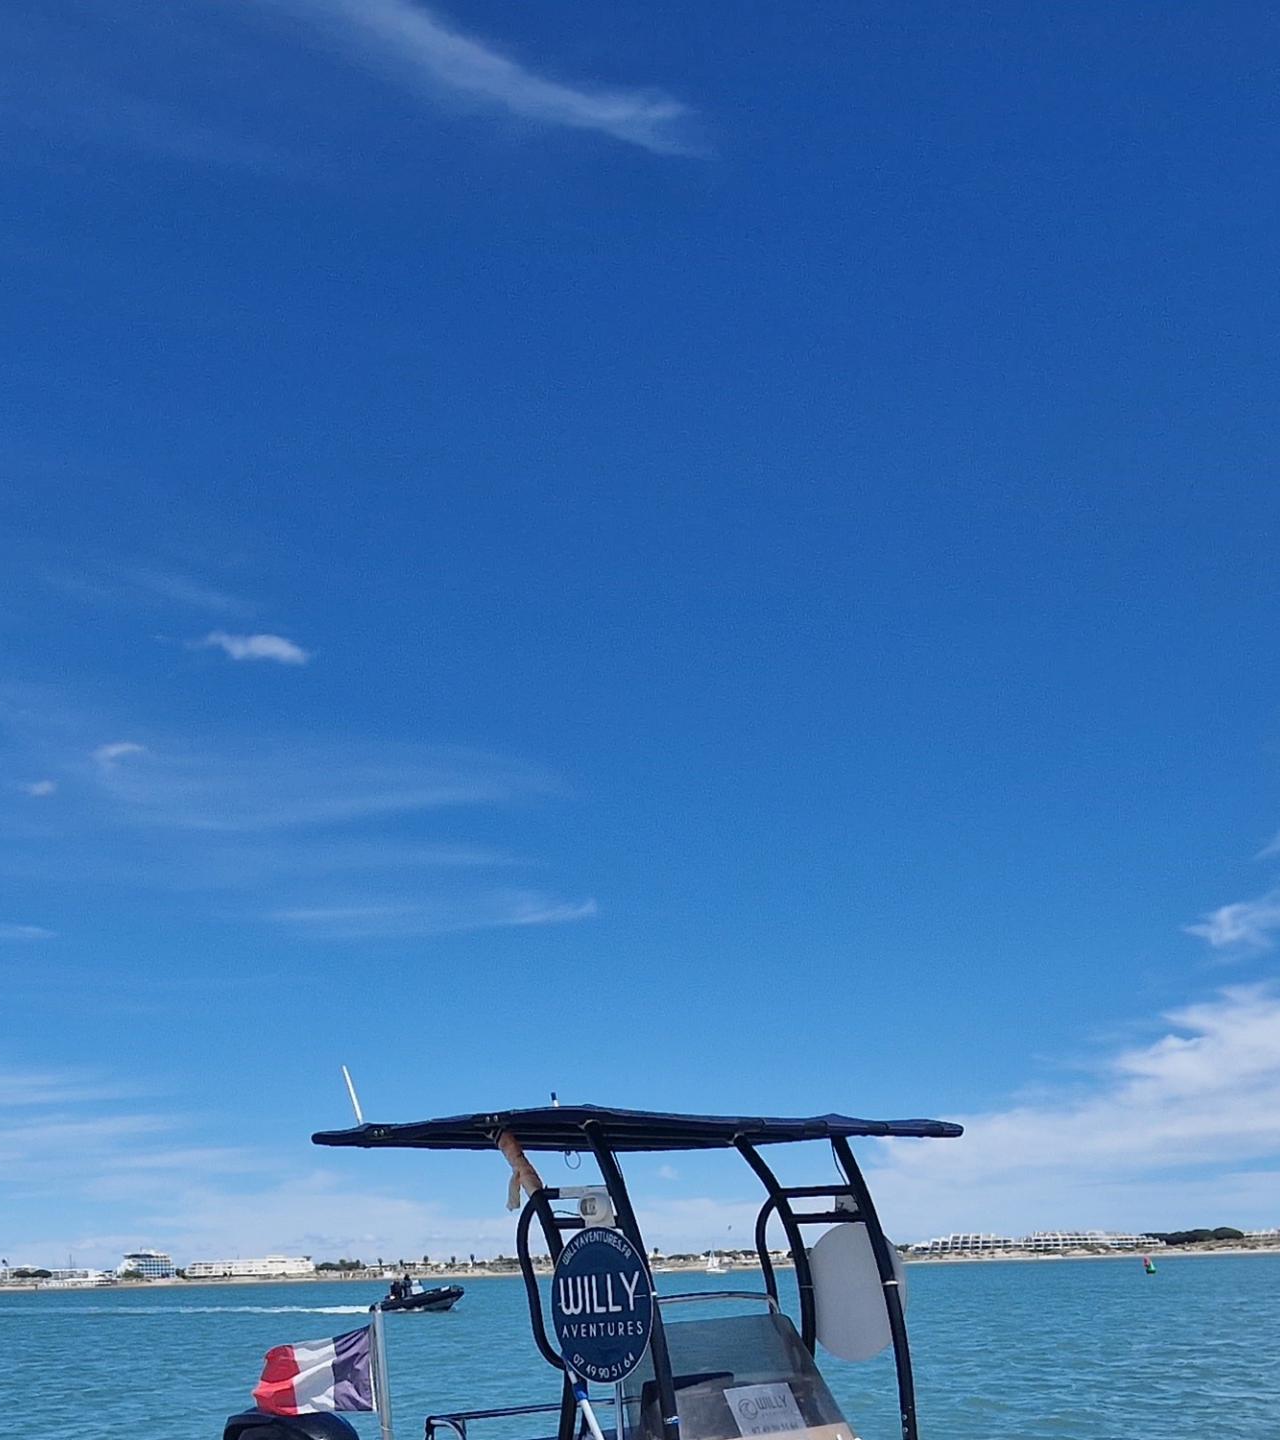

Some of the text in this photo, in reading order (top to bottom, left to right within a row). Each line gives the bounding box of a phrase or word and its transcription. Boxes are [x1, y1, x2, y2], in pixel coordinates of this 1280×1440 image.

[558, 1271, 642, 1315] WILLY
[561, 1320, 644, 1338] AVENTURES
[573, 1353, 585, 1367] 07
[586, 1364, 597, 1377] 49
[598, 1367, 610, 1379] 90
[611, 1362, 623, 1377] 51
